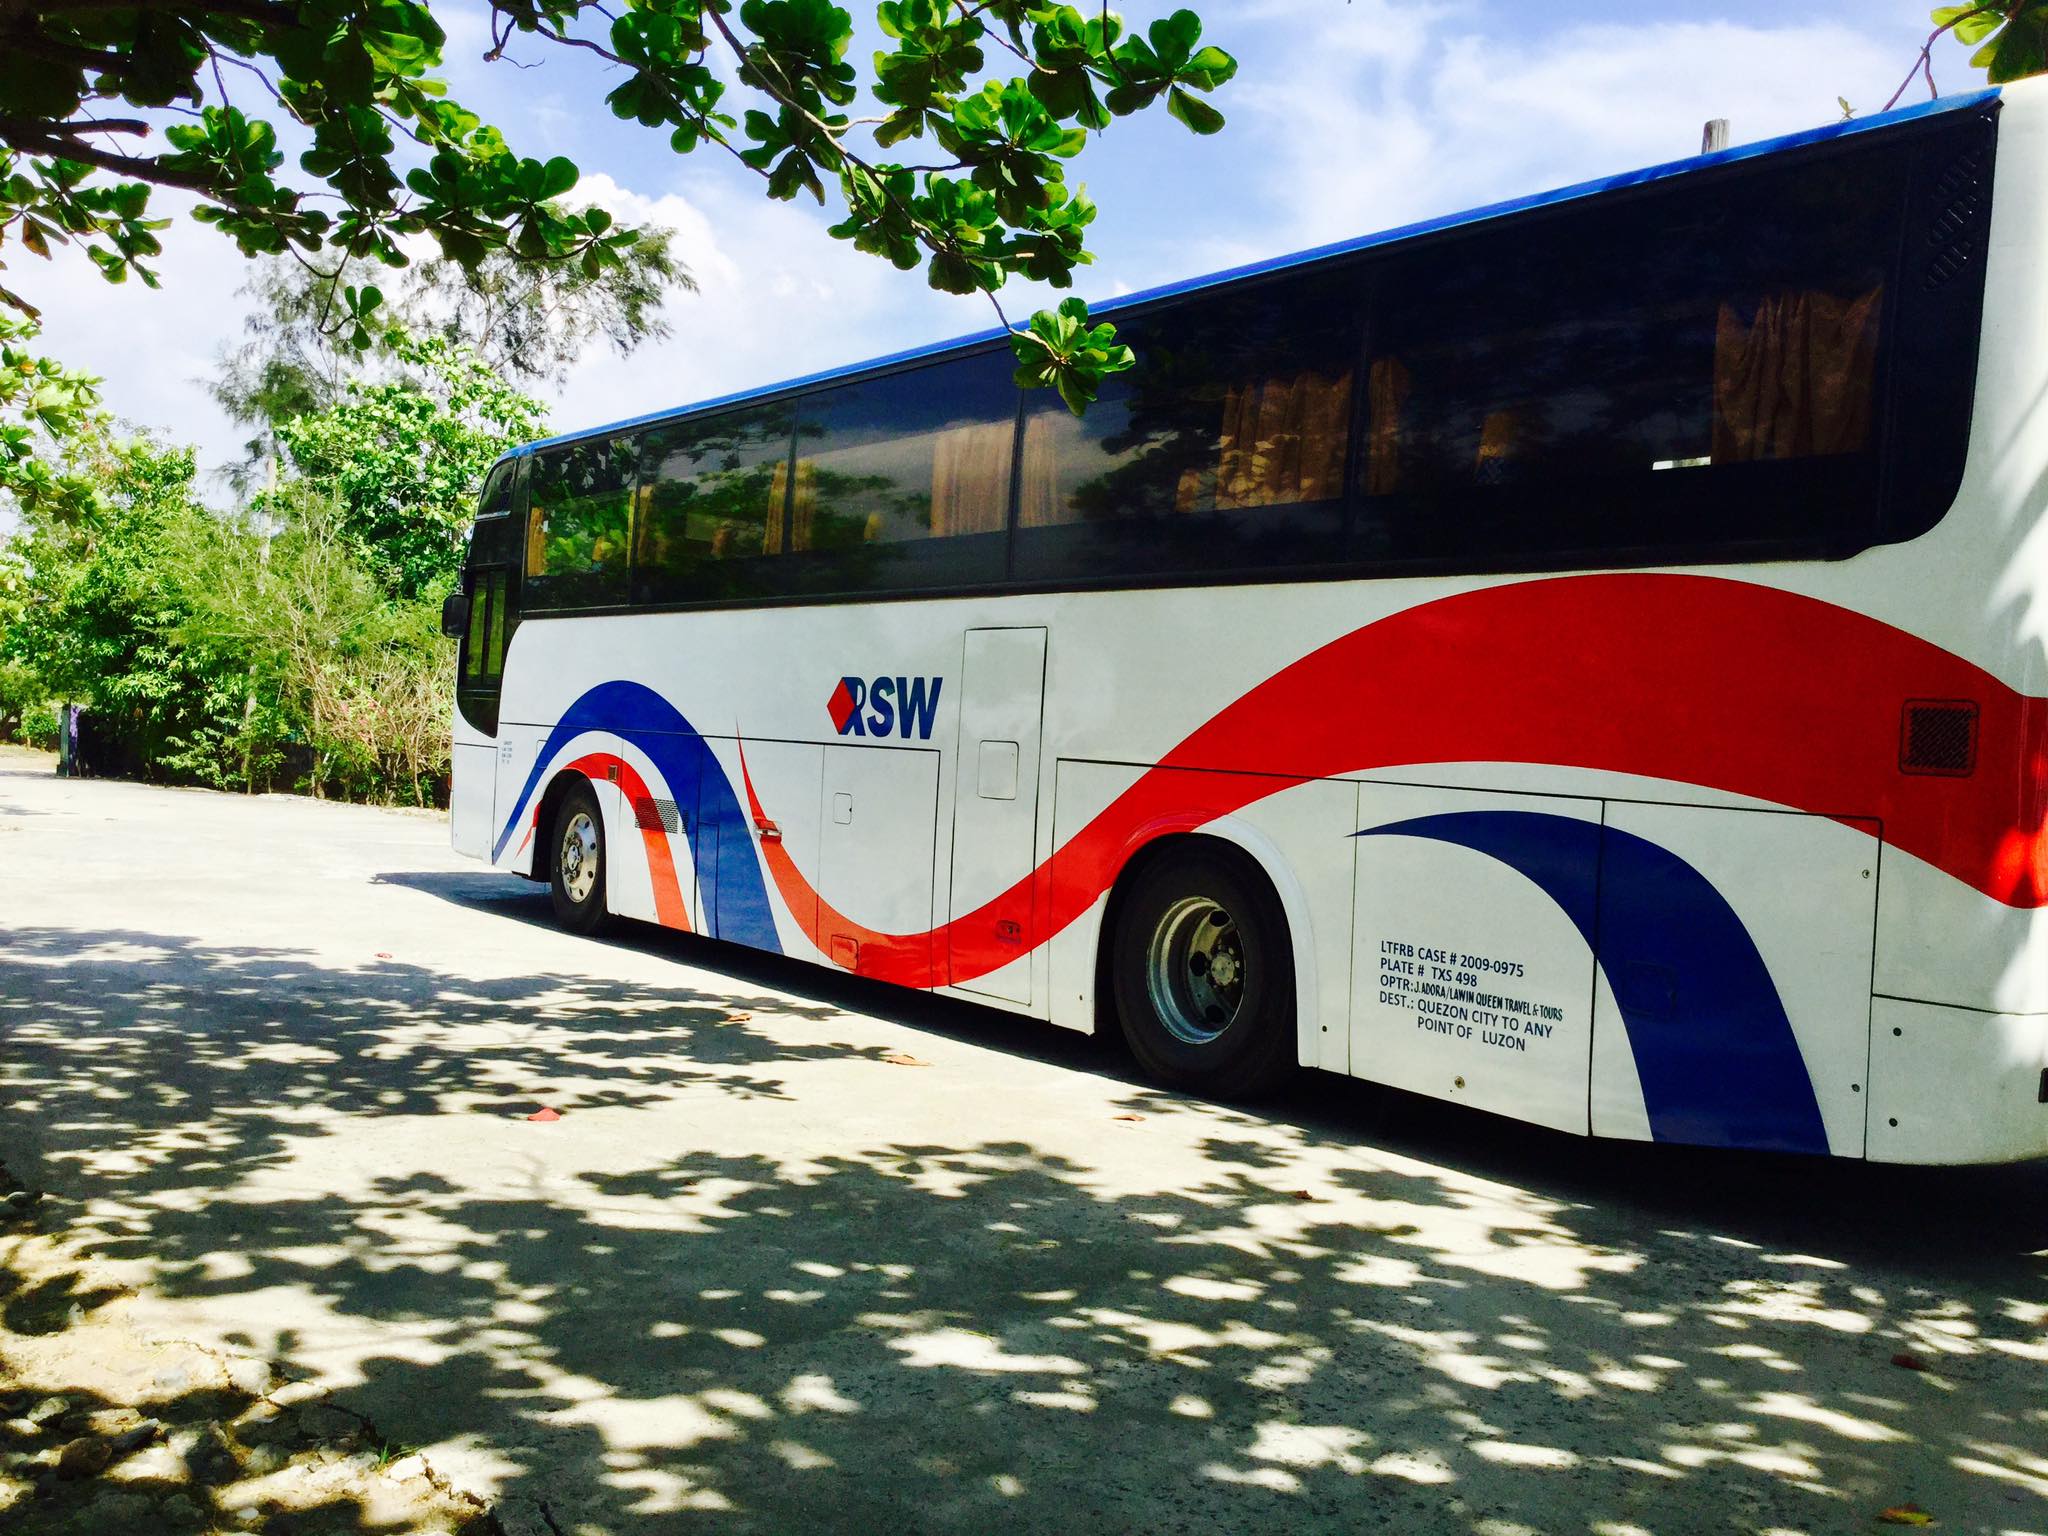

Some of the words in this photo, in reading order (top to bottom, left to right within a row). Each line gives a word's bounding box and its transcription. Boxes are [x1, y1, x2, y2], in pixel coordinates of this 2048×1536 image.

[830, 677, 944, 739] RSW
[1381, 940, 1414, 957] LTFRB
[1418, 948, 1446, 964] CASE
[1450, 954, 1456, 965] #
[1461, 955, 1524, 977] 2009-0975
[1381, 958, 1414, 975] PLATE
[1418, 966, 1424, 976] #
[1432, 967, 1452, 981] TXS
[1456, 971, 1477, 986] 498
[1380, 991, 1414, 1009] DEST.:
[1418, 999, 1468, 1021] QUEZON
[1472, 1011, 1498, 1027] CITY
[1502, 1016, 1518, 1031] TO
[1524, 1022, 1552, 1038] ANY
[1476, 995, 1502, 1010] QUEEN
[1505, 998, 1531, 1016] TRAVEL
[1533, 1005, 1539, 1016] &
[1540, 1005, 1562, 1021] TOURS
[1418, 1017, 1454, 1035] POINT
[1457, 1025, 1472, 1039] OF
[1483, 1031, 1525, 1051] LUZON
